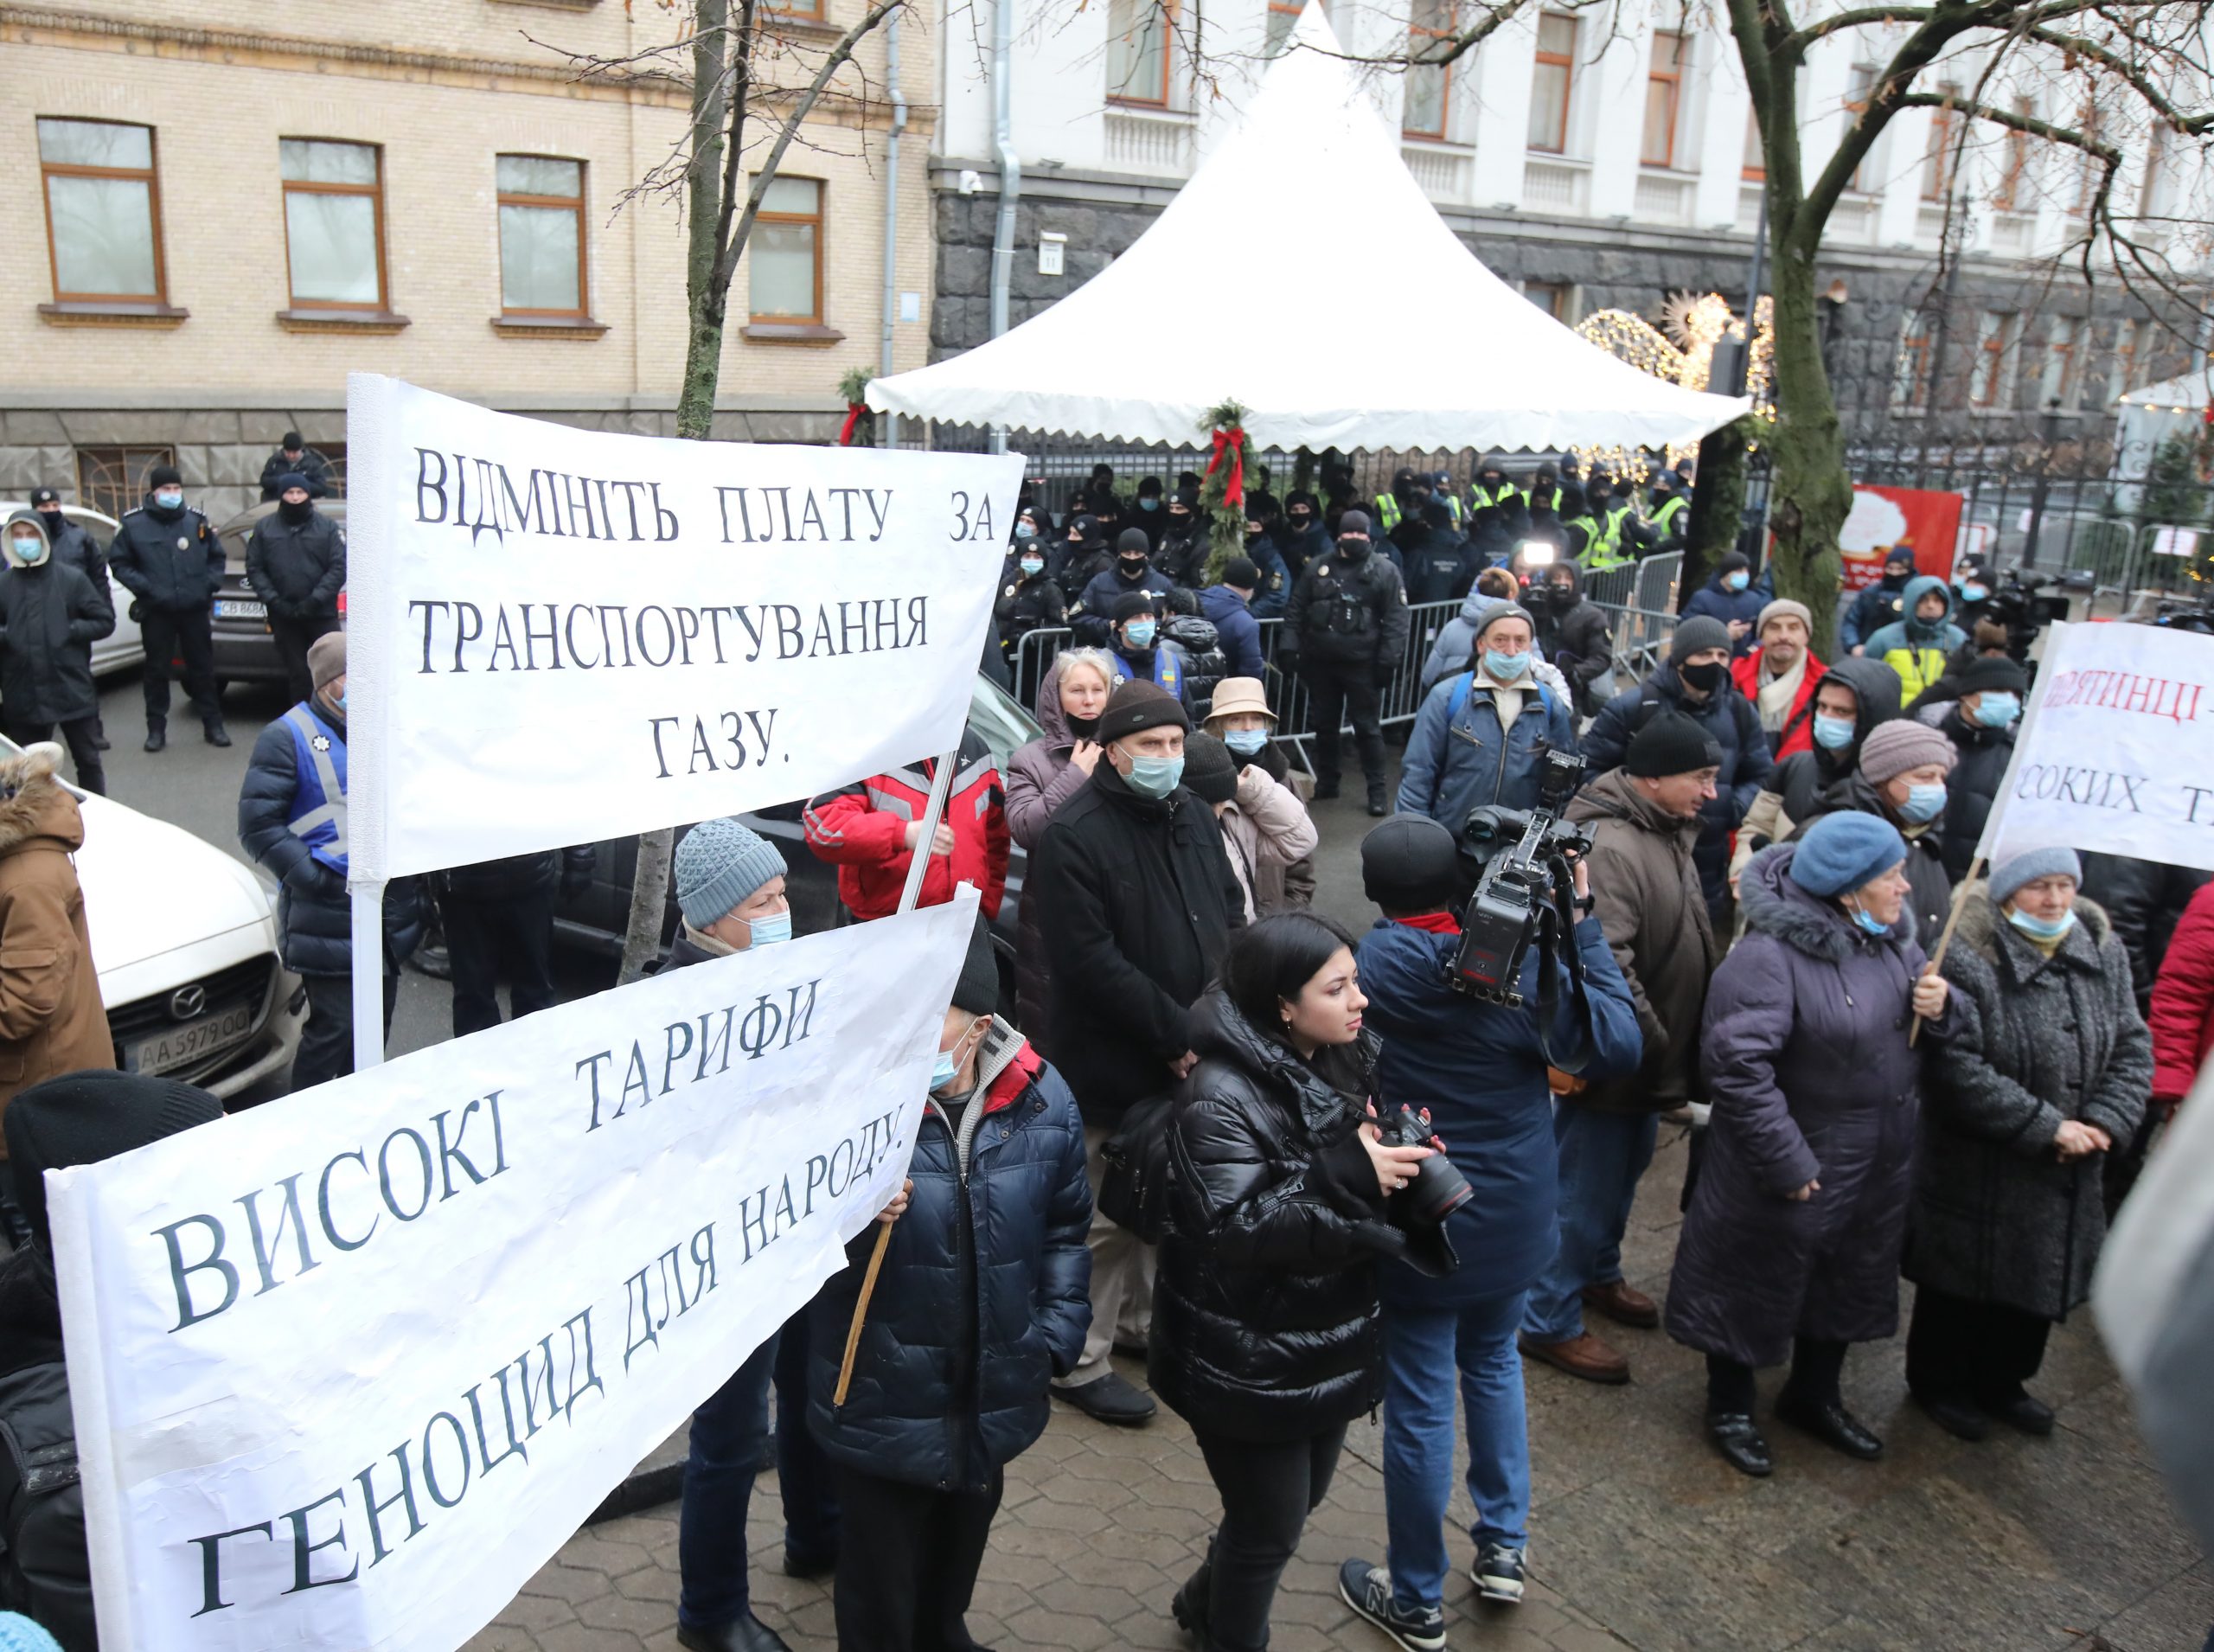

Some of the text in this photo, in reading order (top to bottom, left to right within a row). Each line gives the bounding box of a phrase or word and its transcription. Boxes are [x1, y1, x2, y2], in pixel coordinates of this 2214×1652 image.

[414, 446, 995, 548] ВІДМІНІТЬ ПЛАТУ ЗА
[408, 595, 929, 674] ТРАНСПОРТУВАННЯ
[648, 708, 790, 779] ГАЗУ.
[2181, 785, 2214, 827] Т
[142, 1040, 170, 1069] AA
[176, 1022, 217, 1056] 5979
[150, 978, 822, 1334] ВИСОКІ ТАРИФИ
[187, 1101, 905, 1618] ГЕНОЦИД ДЛЯ НАРОДУ.
